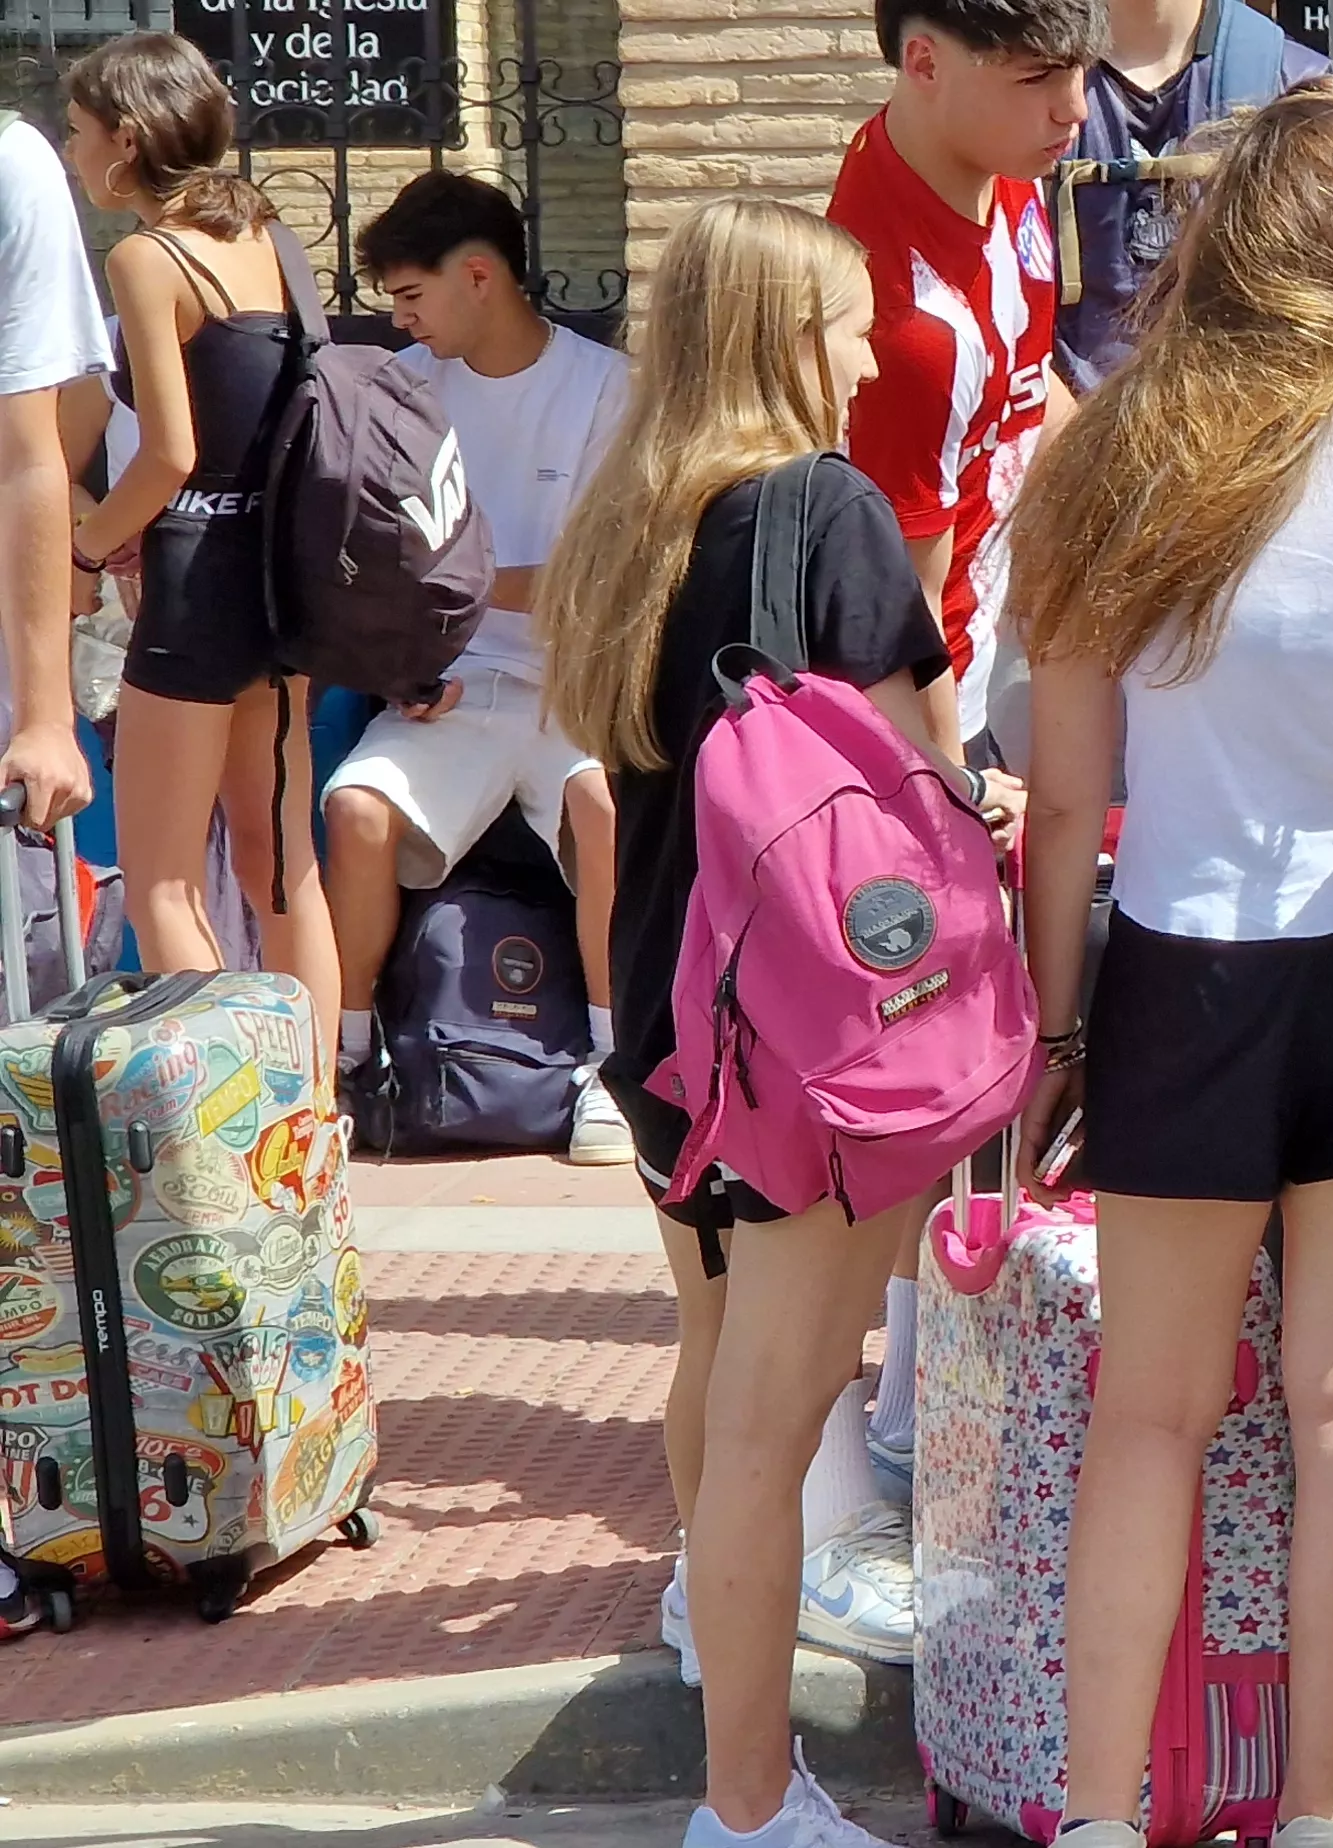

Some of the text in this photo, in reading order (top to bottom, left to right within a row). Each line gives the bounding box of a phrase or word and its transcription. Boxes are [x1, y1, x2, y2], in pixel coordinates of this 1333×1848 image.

[250, 23, 381, 67] y de la
[142, 1238, 229, 1273] AEROBATI
